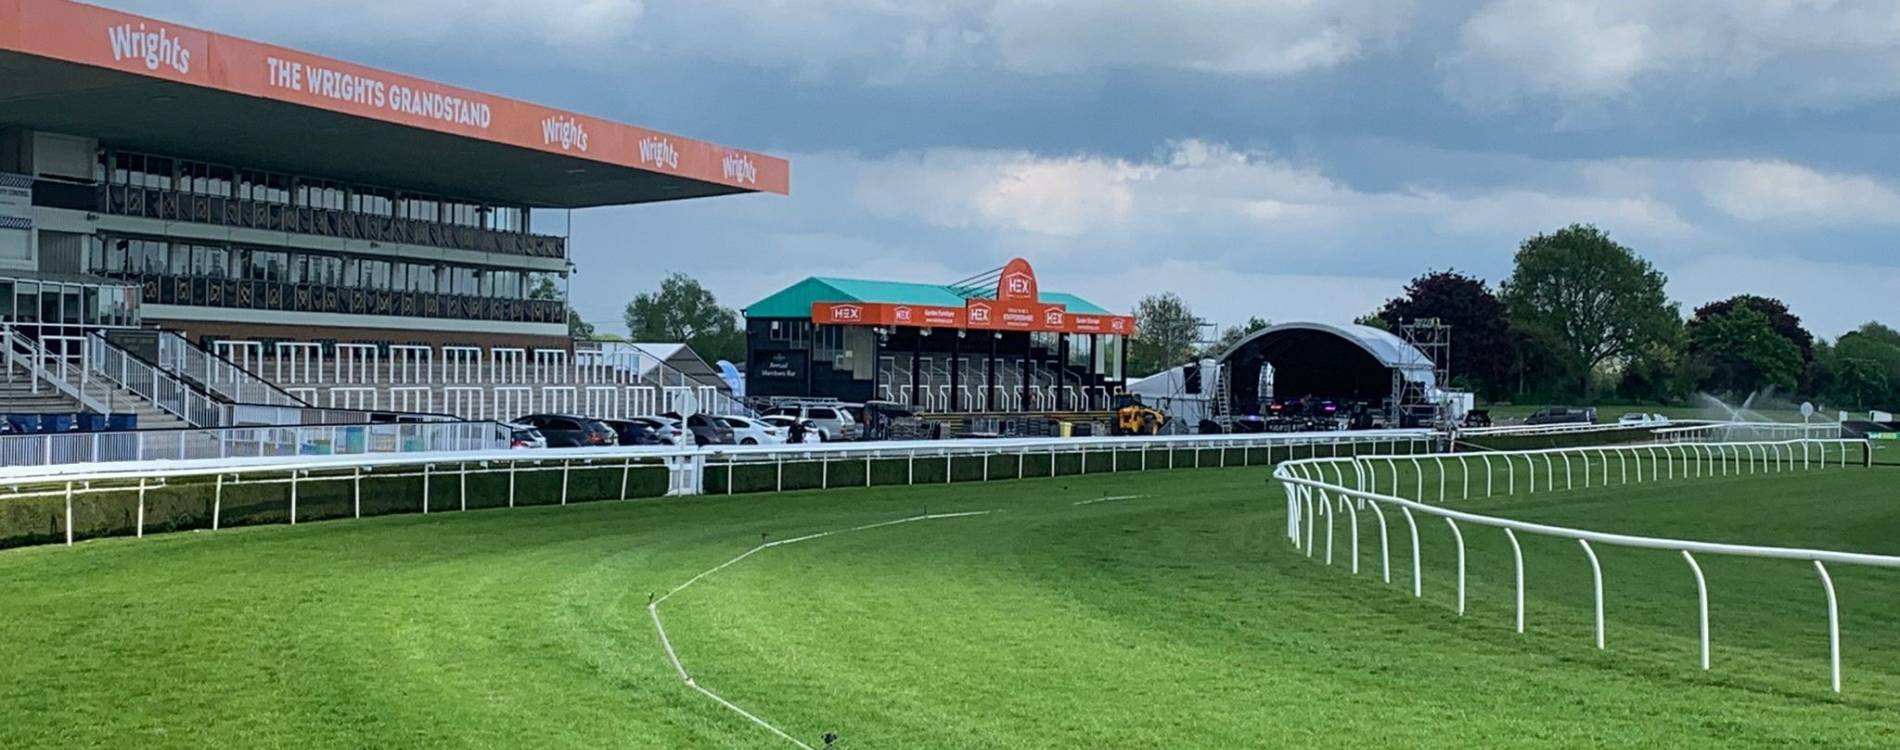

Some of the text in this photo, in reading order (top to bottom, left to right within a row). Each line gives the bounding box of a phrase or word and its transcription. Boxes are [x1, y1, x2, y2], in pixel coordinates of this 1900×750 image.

[108, 22, 190, 74] Wrights
[266, 57, 491, 129] THE WRIGHTS GRANDSTAND
[542, 115, 588, 151] Wrights
[639, 136, 680, 169] Wrights
[722, 153, 757, 184] Wrights
[1008, 278, 1030, 294] HEX
[834, 308, 859, 319] HEX
[896, 311, 910, 320] HEX
[971, 308, 989, 322] HEX
[1046, 312, 1063, 325] HEX
